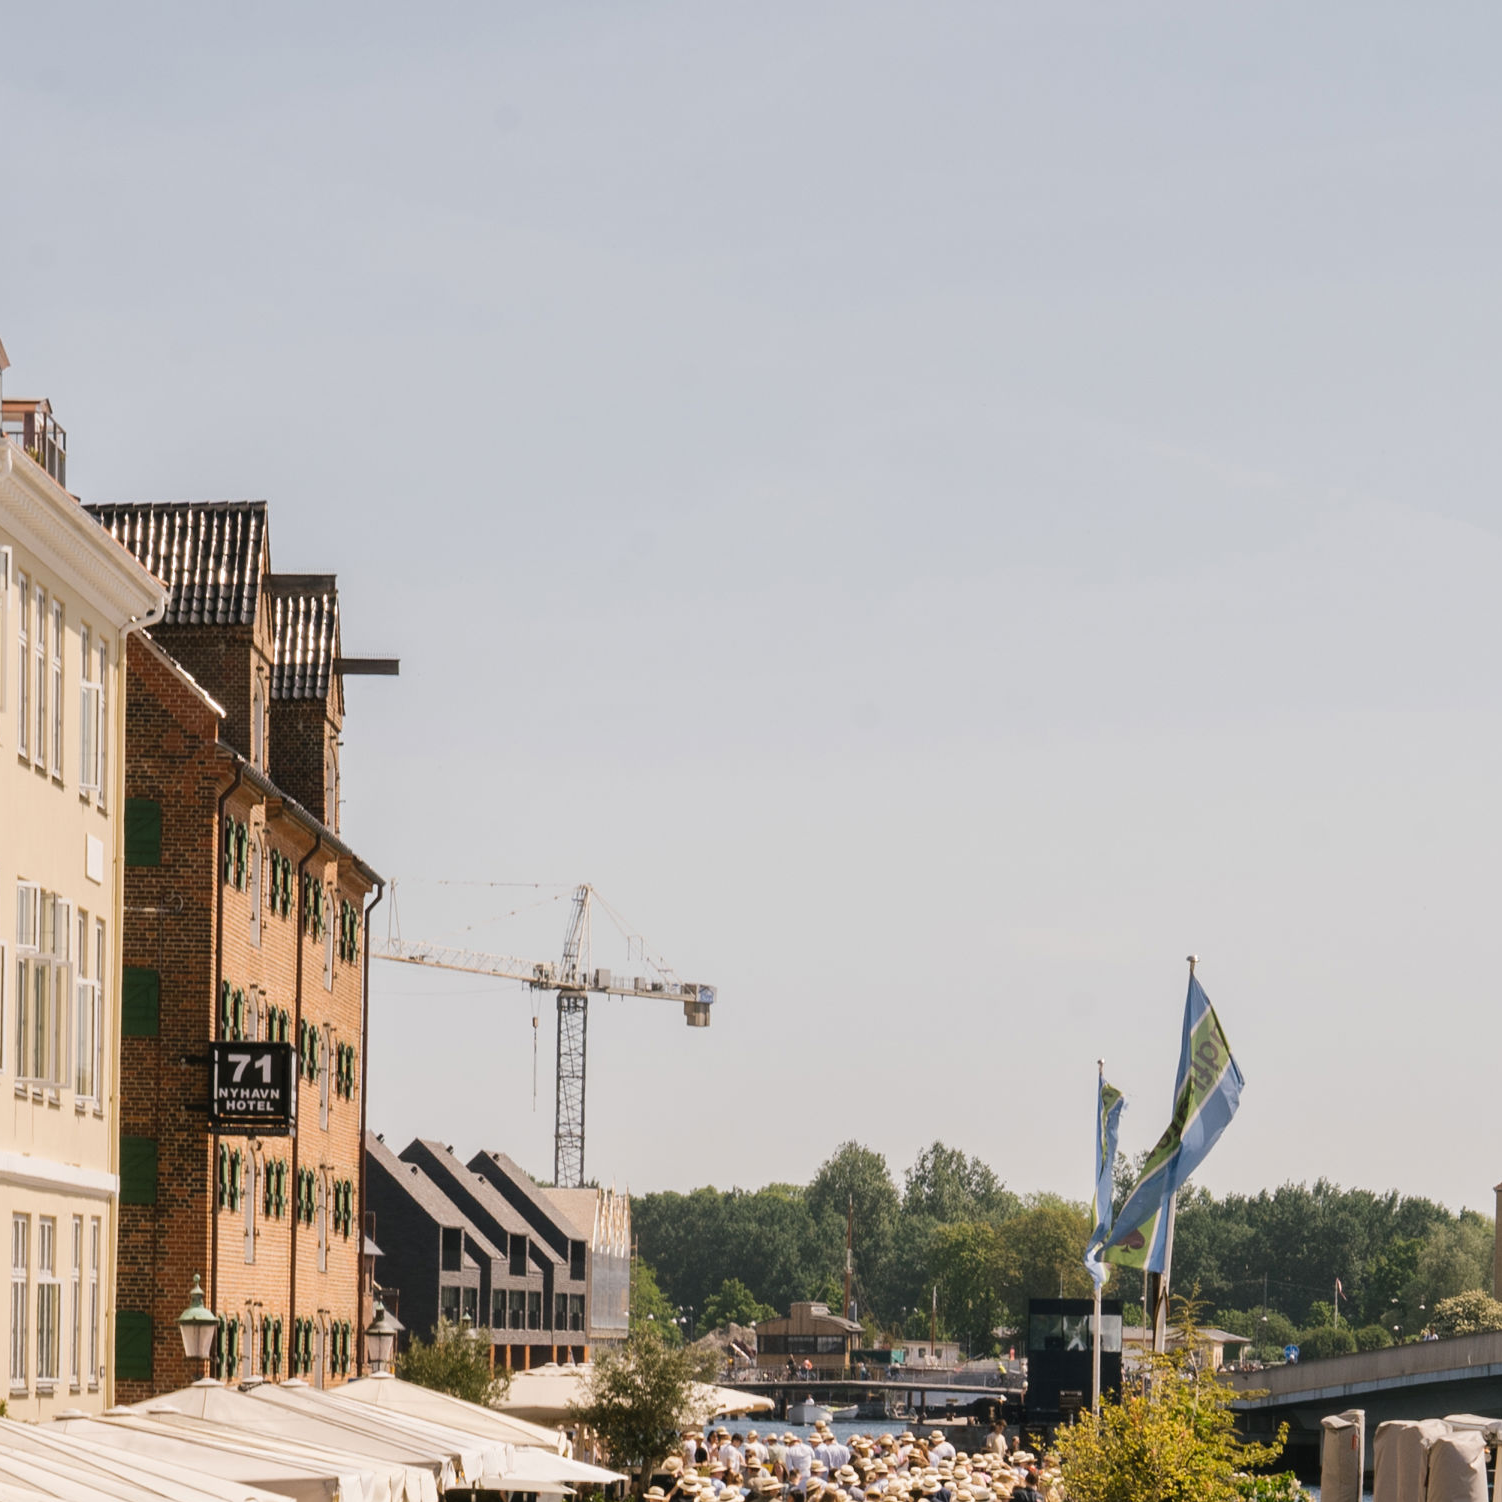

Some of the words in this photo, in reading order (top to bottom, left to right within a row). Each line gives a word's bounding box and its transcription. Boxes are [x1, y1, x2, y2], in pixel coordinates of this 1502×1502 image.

[228, 1054, 271, 1084] 71
[218, 1088, 280, 1100] NYHAVN
[225, 1101, 274, 1112] HOTEL
